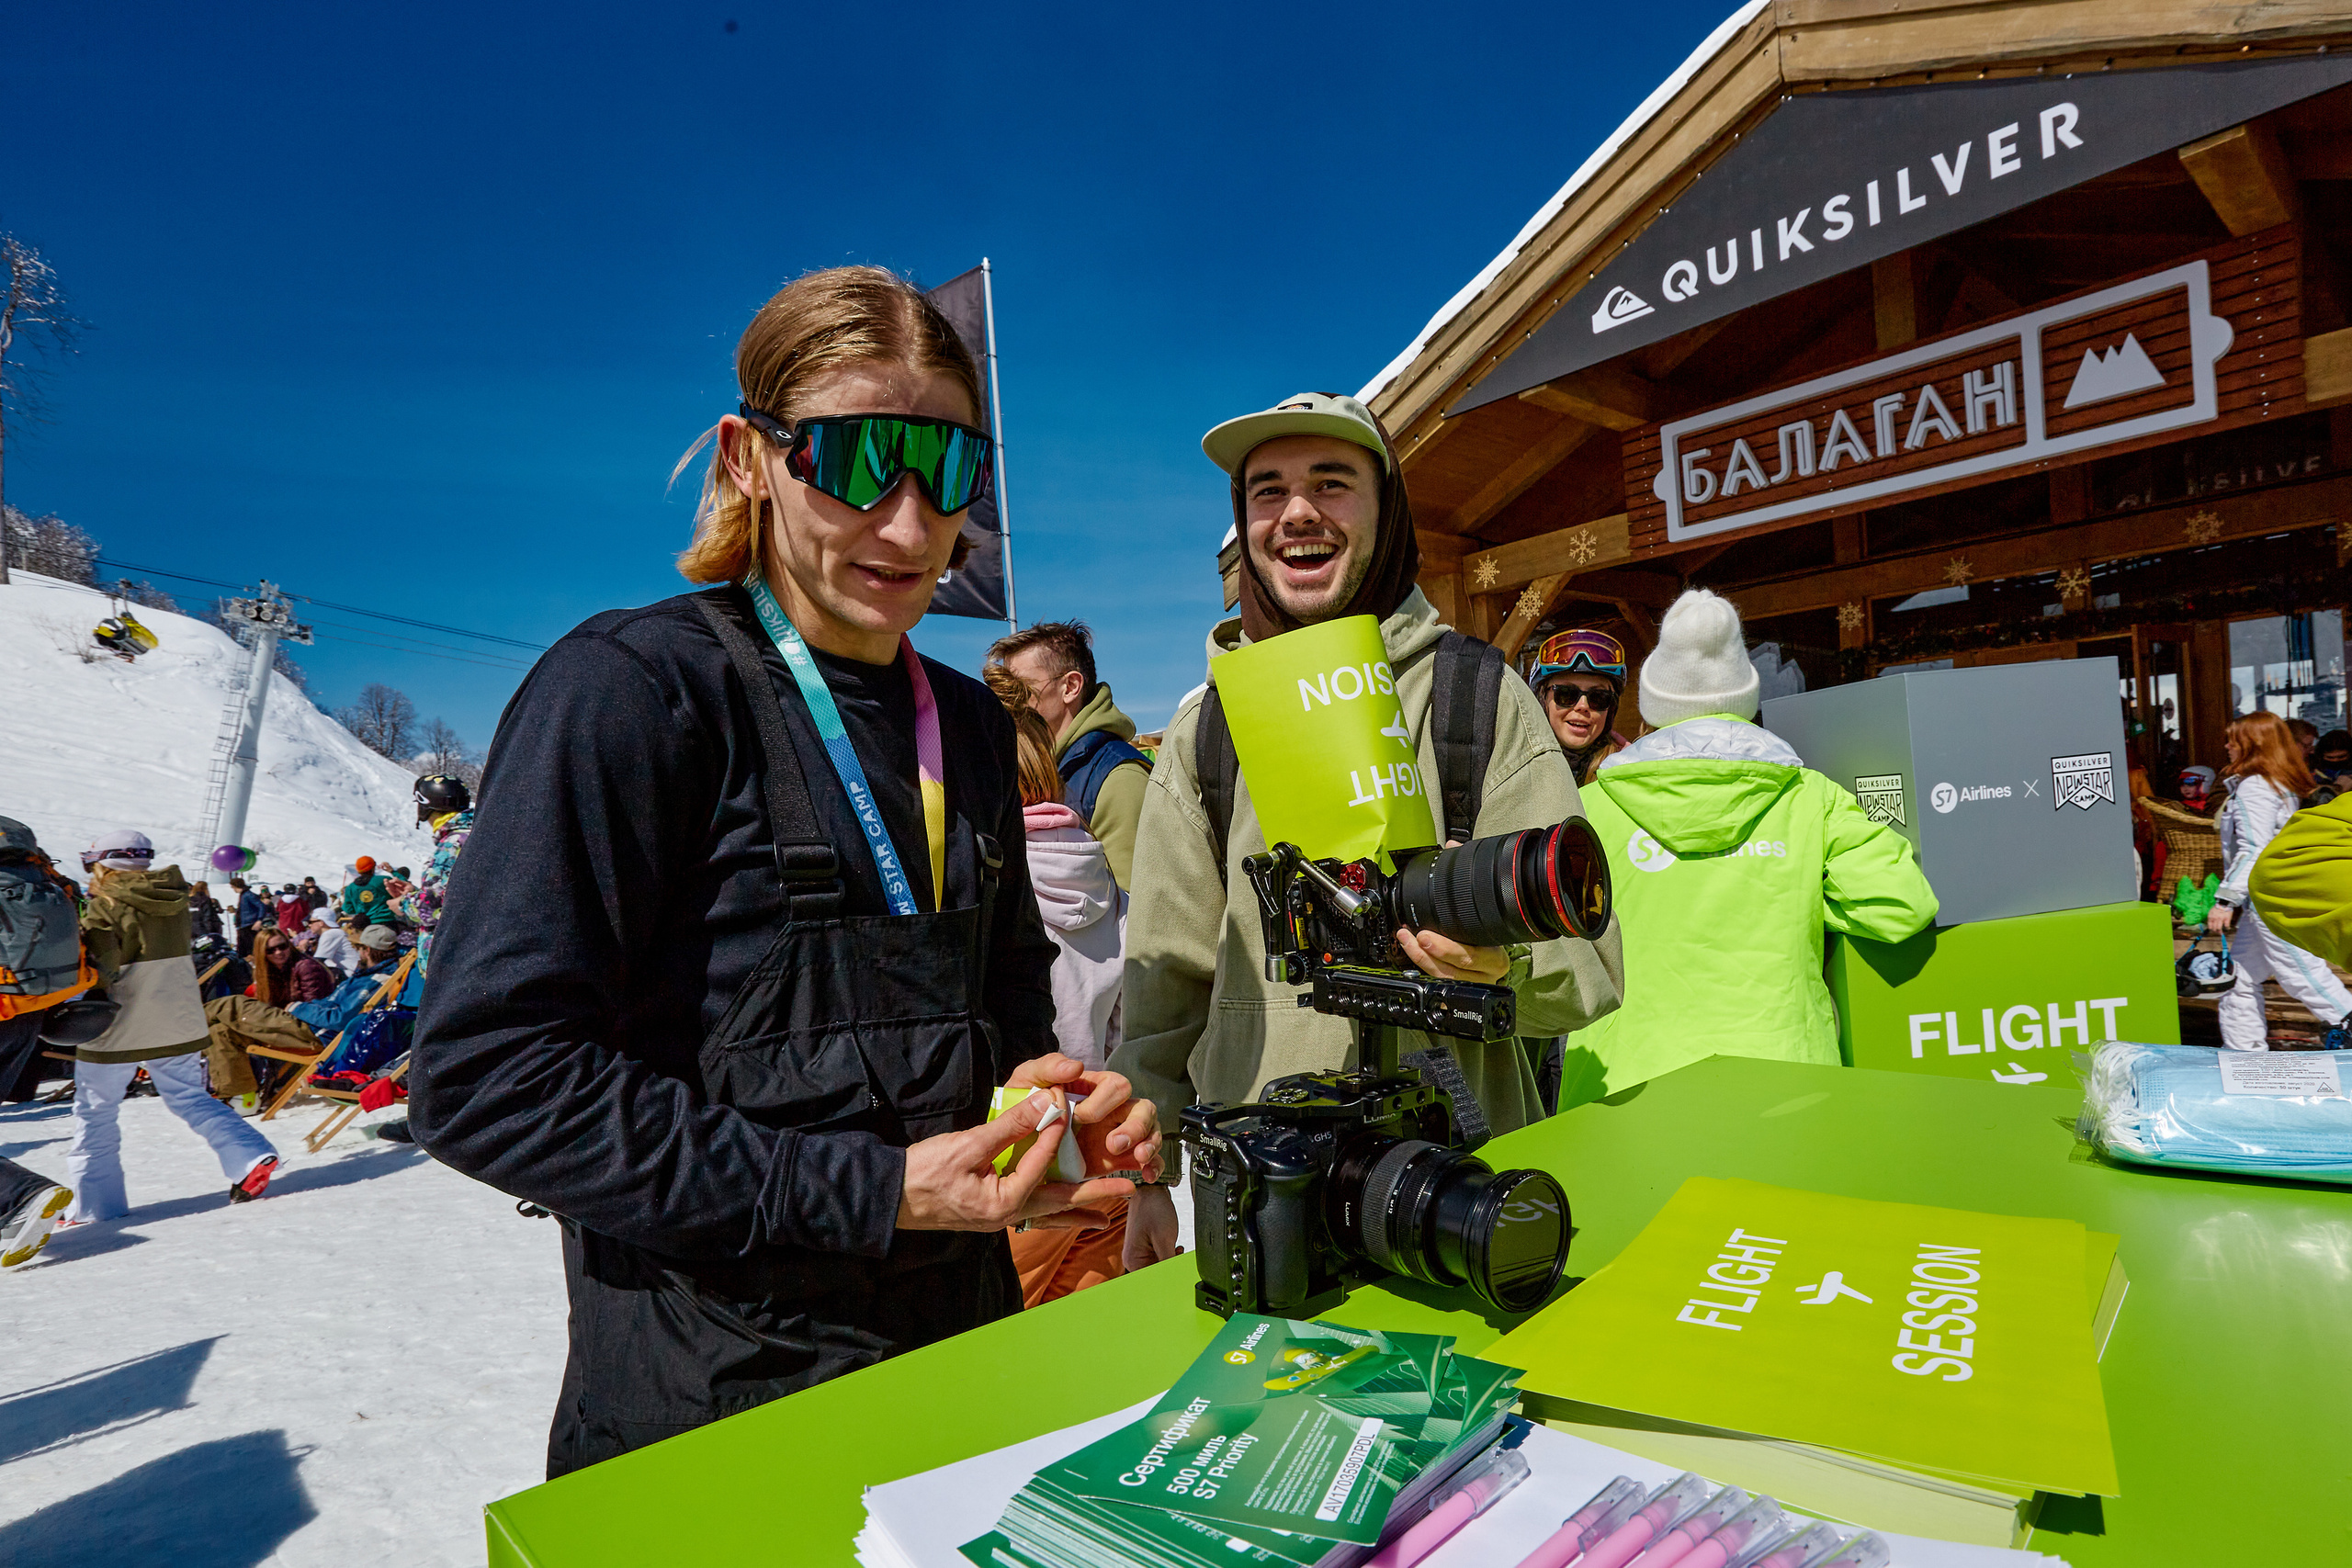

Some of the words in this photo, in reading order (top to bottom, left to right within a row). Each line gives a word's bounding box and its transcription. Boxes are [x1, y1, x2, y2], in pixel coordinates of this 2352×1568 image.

[1662, 102, 2084, 302] QUIKSILVER
[1682, 360, 2018, 504] БАЛАГАН
[1297, 661, 1398, 712] SION
[1348, 761, 1423, 807] IGHT
[1857, 778, 1900, 788] QUIKSILVER
[2055, 757, 2109, 770] QUIKSILVER
[849, 781, 881, 837] CAMP
[1936, 789, 1953, 807] S7
[1960, 784, 2012, 802] Airlines
[2074, 794, 2096, 803] CAMP
[876, 842, 903, 895] STAR
[1453, 1009, 1483, 1024] SmallRig
[1909, 997, 2128, 1059] FLIGHT
[1199, 1134, 1227, 1152] SmallRig
[1676, 1227, 1788, 1331] FLIGHT
[1892, 1243, 1981, 1382] SESSION
[1229, 1351, 1248, 1365] S7
[1239, 1323, 1271, 1351] Airlines
[1118, 1396, 1211, 1487] Сертификат
[1166, 1468, 1201, 1495] 500
[1192, 1435, 1227, 1467] миль
[1193, 1478, 1221, 1500] S7
[1207, 1432, 1260, 1479] Priority
[1324, 1433, 1376, 1515] AV17035907PDL
